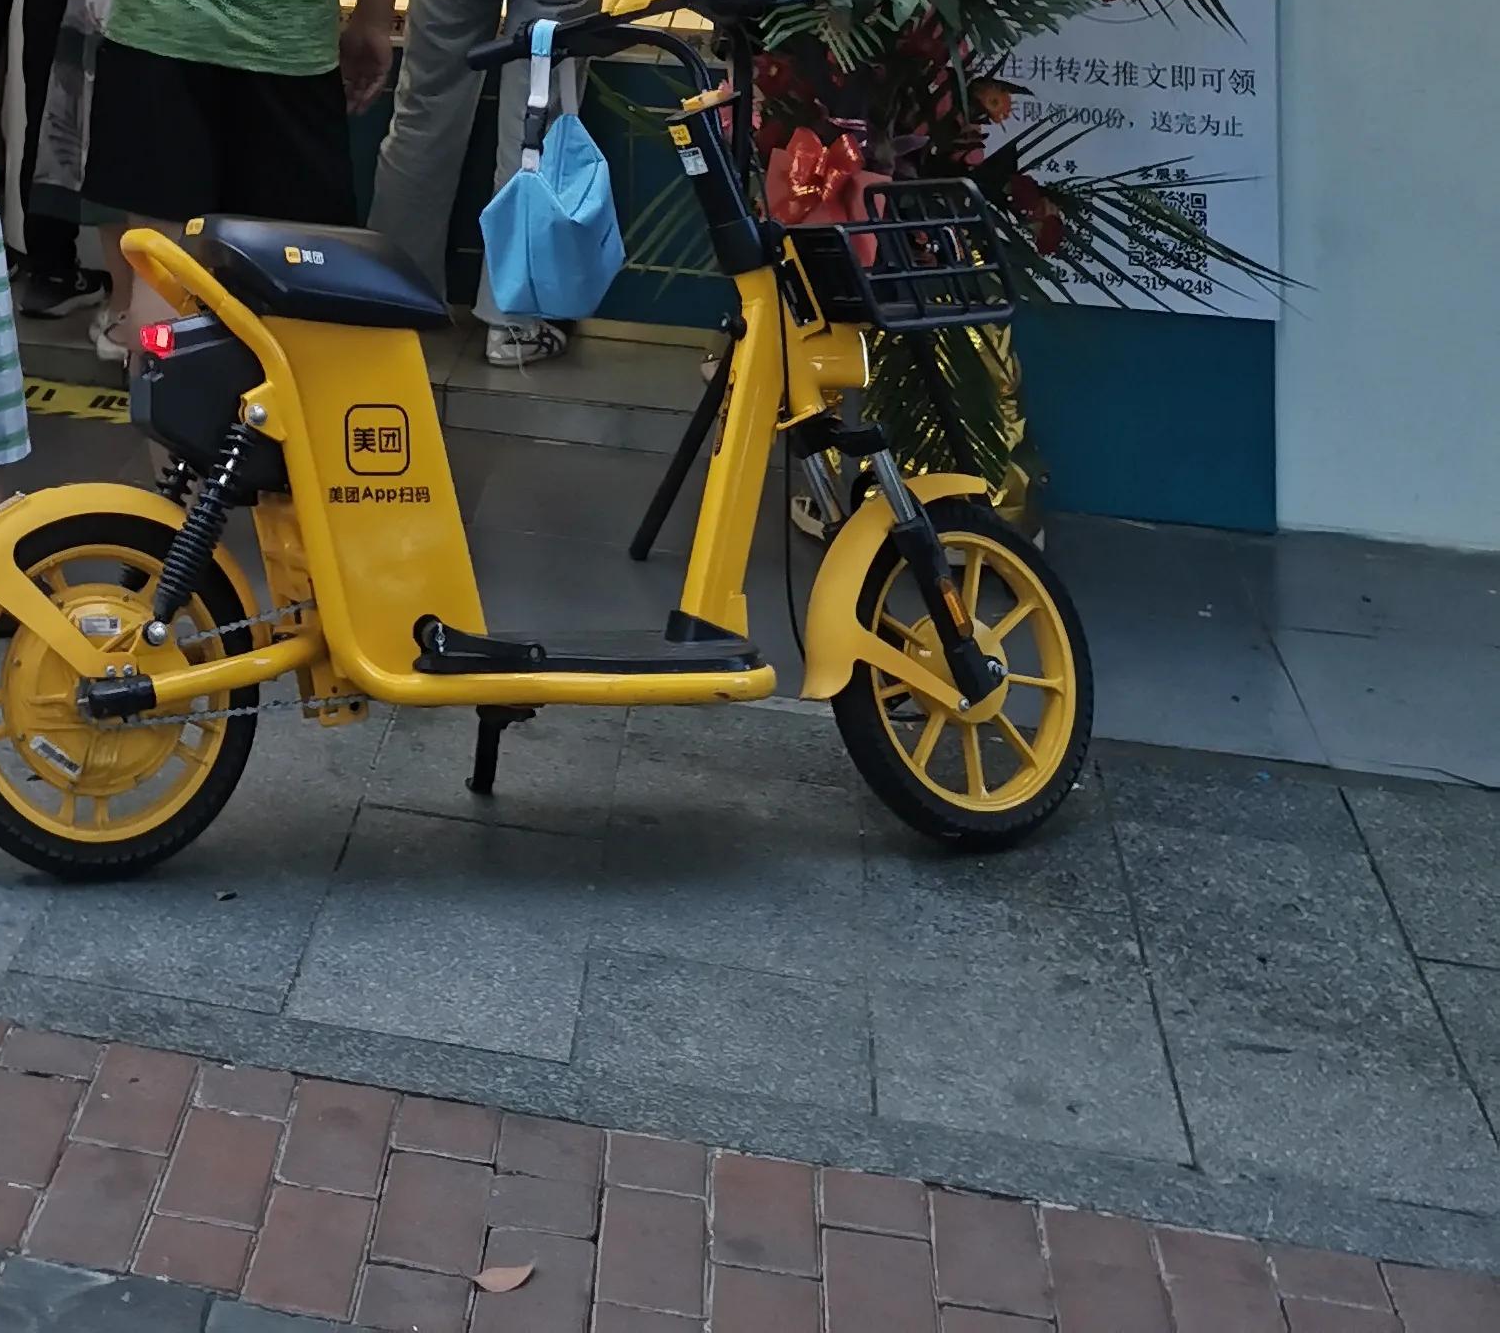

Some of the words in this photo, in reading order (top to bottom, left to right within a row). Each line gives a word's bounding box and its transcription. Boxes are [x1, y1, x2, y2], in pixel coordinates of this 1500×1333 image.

[1036, 158, 1078, 174] 众号
[353, 427, 401, 453] 美团
[329, 486, 431, 503] 美团App扫码
